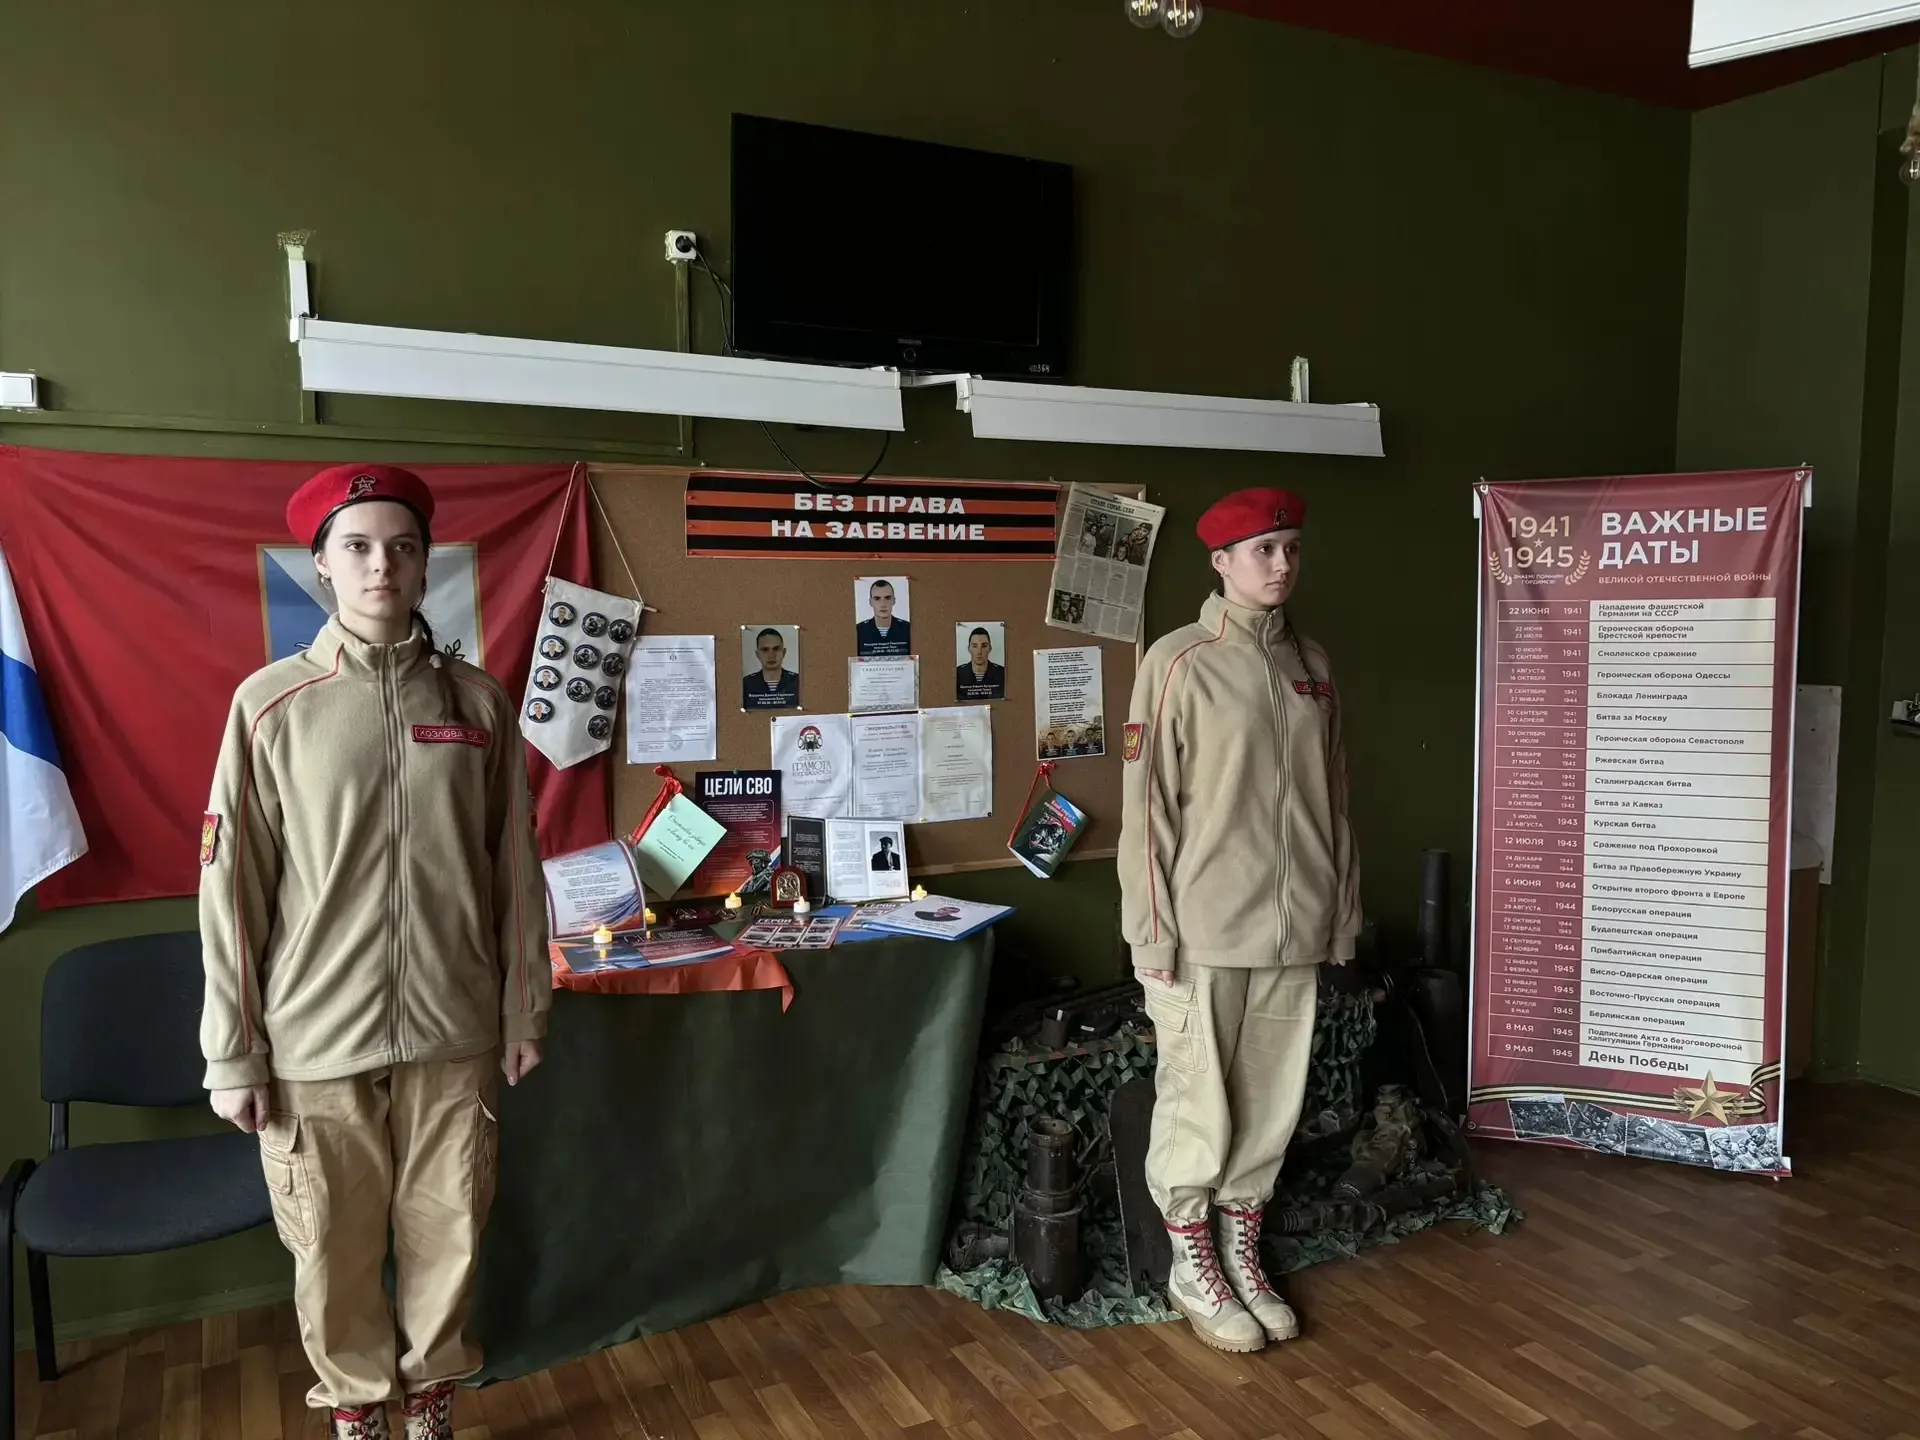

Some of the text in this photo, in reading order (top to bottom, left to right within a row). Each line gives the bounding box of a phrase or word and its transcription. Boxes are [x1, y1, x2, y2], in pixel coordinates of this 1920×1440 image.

[794, 493, 965, 514] БЕЗ ПРАВА
[1508, 516, 1569, 538] 1941
[1601, 507, 1768, 536] ВАЖНЫЕ
[771, 520, 985, 540] НА ЗАБВЕНИЕ
[1504, 546, 1574, 568] 1945
[1598, 540, 1699, 569] ДАТЫ
[1599, 572, 1772, 584] ВЕЛИКОЙ ОТЕЧЕСТВЕННОЙ ВОЙНЫ
[1635, 693, 1688, 701] Ленинграда
[704, 778, 742, 797] ЦЕЛИ
[746, 777, 772, 794] СВО
[1594, 778, 1664, 786] Сталинградская
[1557, 839, 1577, 847] 1943
[1593, 841, 1637, 849] Сражение
[1658, 845, 1718, 854] Прохоровкой
[1630, 865, 1702, 876] Правобережную
[1704, 870, 1742, 878] Украину
[1513, 878, 1541, 887] ИЮНЯ
[1592, 884, 1633, 893] Открытие
[1671, 889, 1704, 898] фронта
[1714, 892, 1745, 901] Европе
[1592, 905, 1692, 918] Белорусская операция
[1591, 926, 1698, 940] Будапештская операция
[1554, 944, 1575, 952] 1944
[1590, 947, 1702, 962] Прибалтийская операция
[1554, 964, 1575, 973] 1945
[1590, 968, 1708, 984] Висло-Одерская операция
[1553, 986, 1574, 994] 1945
[1590, 990, 1720, 1008] Восточно-Прусская операция
[1553, 1006, 1574, 1015] 1945
[1589, 1011, 1686, 1026] Берлинская операция
[1514, 1024, 1534, 1032] МАЯ
[1552, 1028, 1573, 1036] 1945
[1588, 1028, 1638, 1039] Подписание
[1641, 1034, 1660, 1042] Акта
[1671, 1037, 1743, 1051] безоговорочной
[1588, 1035, 1684, 1051] капитуляции Германии
[1513, 1044, 1534, 1052] МАЯ
[1552, 1049, 1572, 1057] 1945
[1588, 1051, 1689, 1072] День Победы
